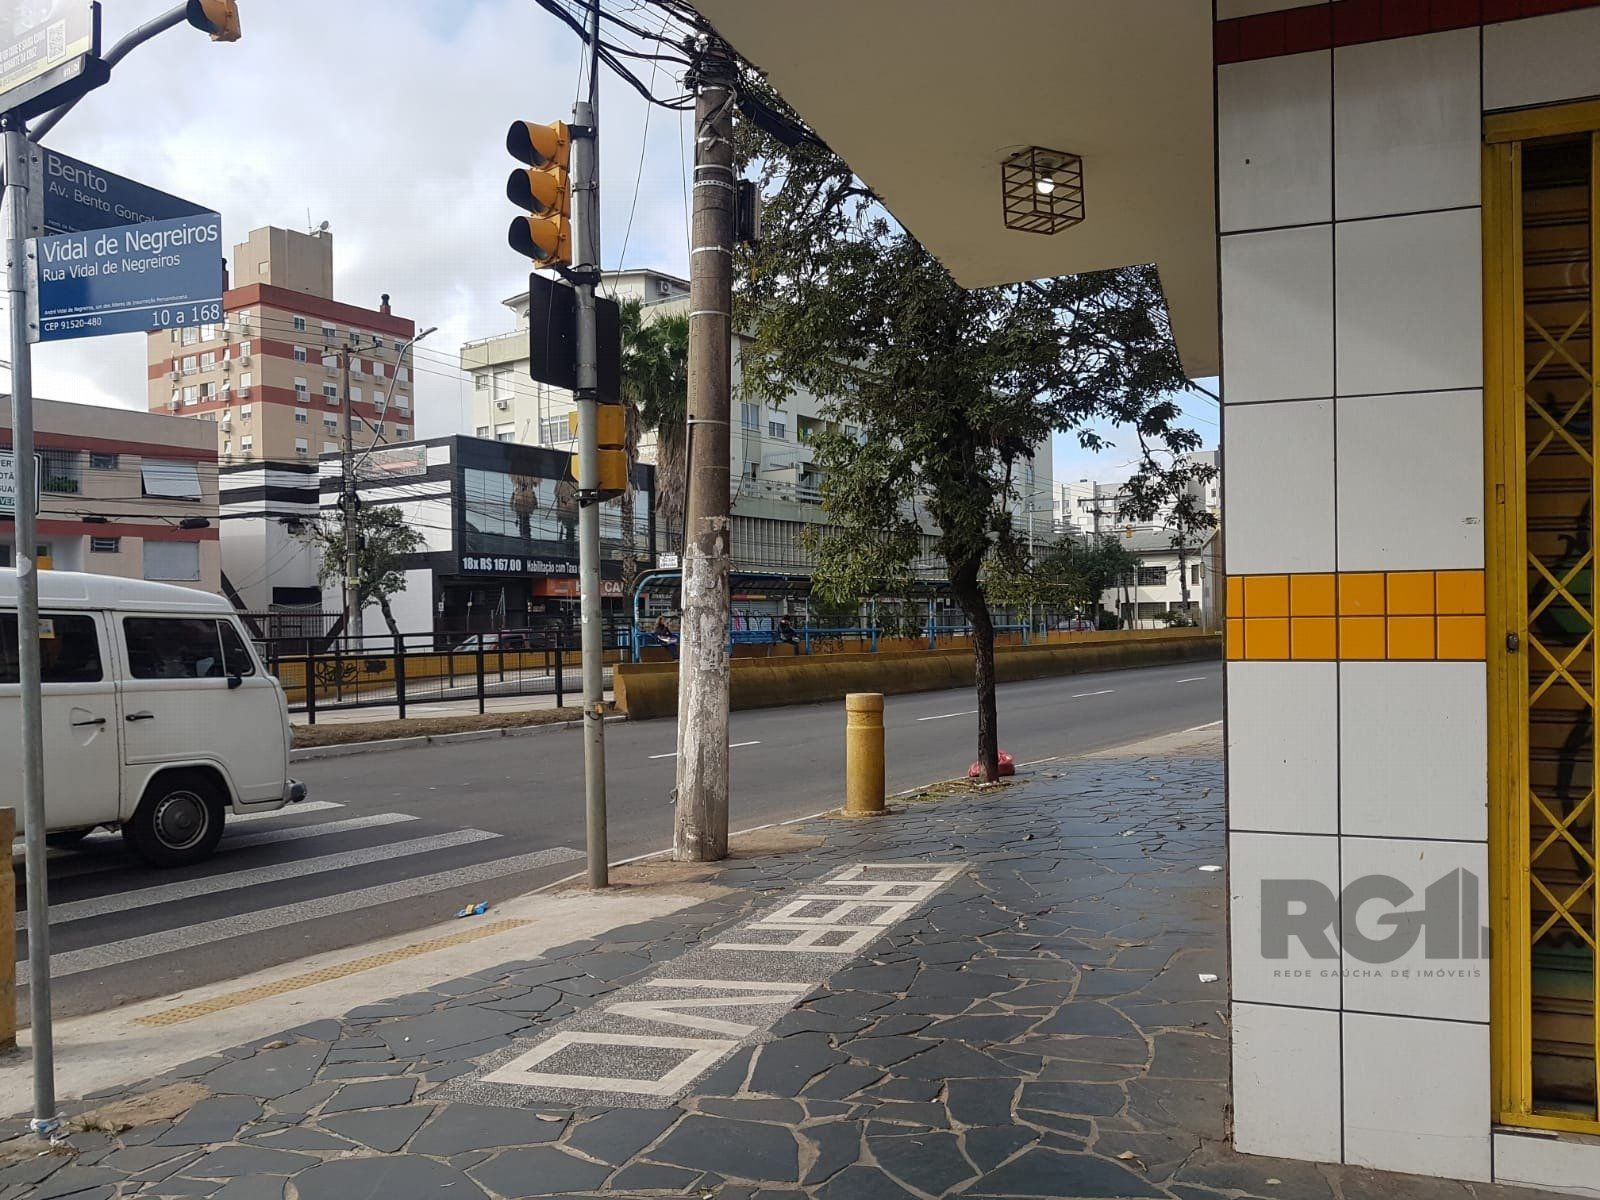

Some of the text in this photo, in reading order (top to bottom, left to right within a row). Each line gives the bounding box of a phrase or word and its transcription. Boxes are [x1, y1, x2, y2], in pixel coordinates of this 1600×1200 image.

[48, 154, 108, 193] Bento
[48, 181, 69, 198] Av.
[74, 189, 110, 212] Bento
[43, 223, 218, 263] Vidal de Negreiros
[43, 254, 181, 282] Rua Vidal de Negreiros
[44, 304, 220, 332] CEP 91520-480 10 a 168
[462, 557, 577, 575] 18x R$ 167,00 Habilitação com Taxa
